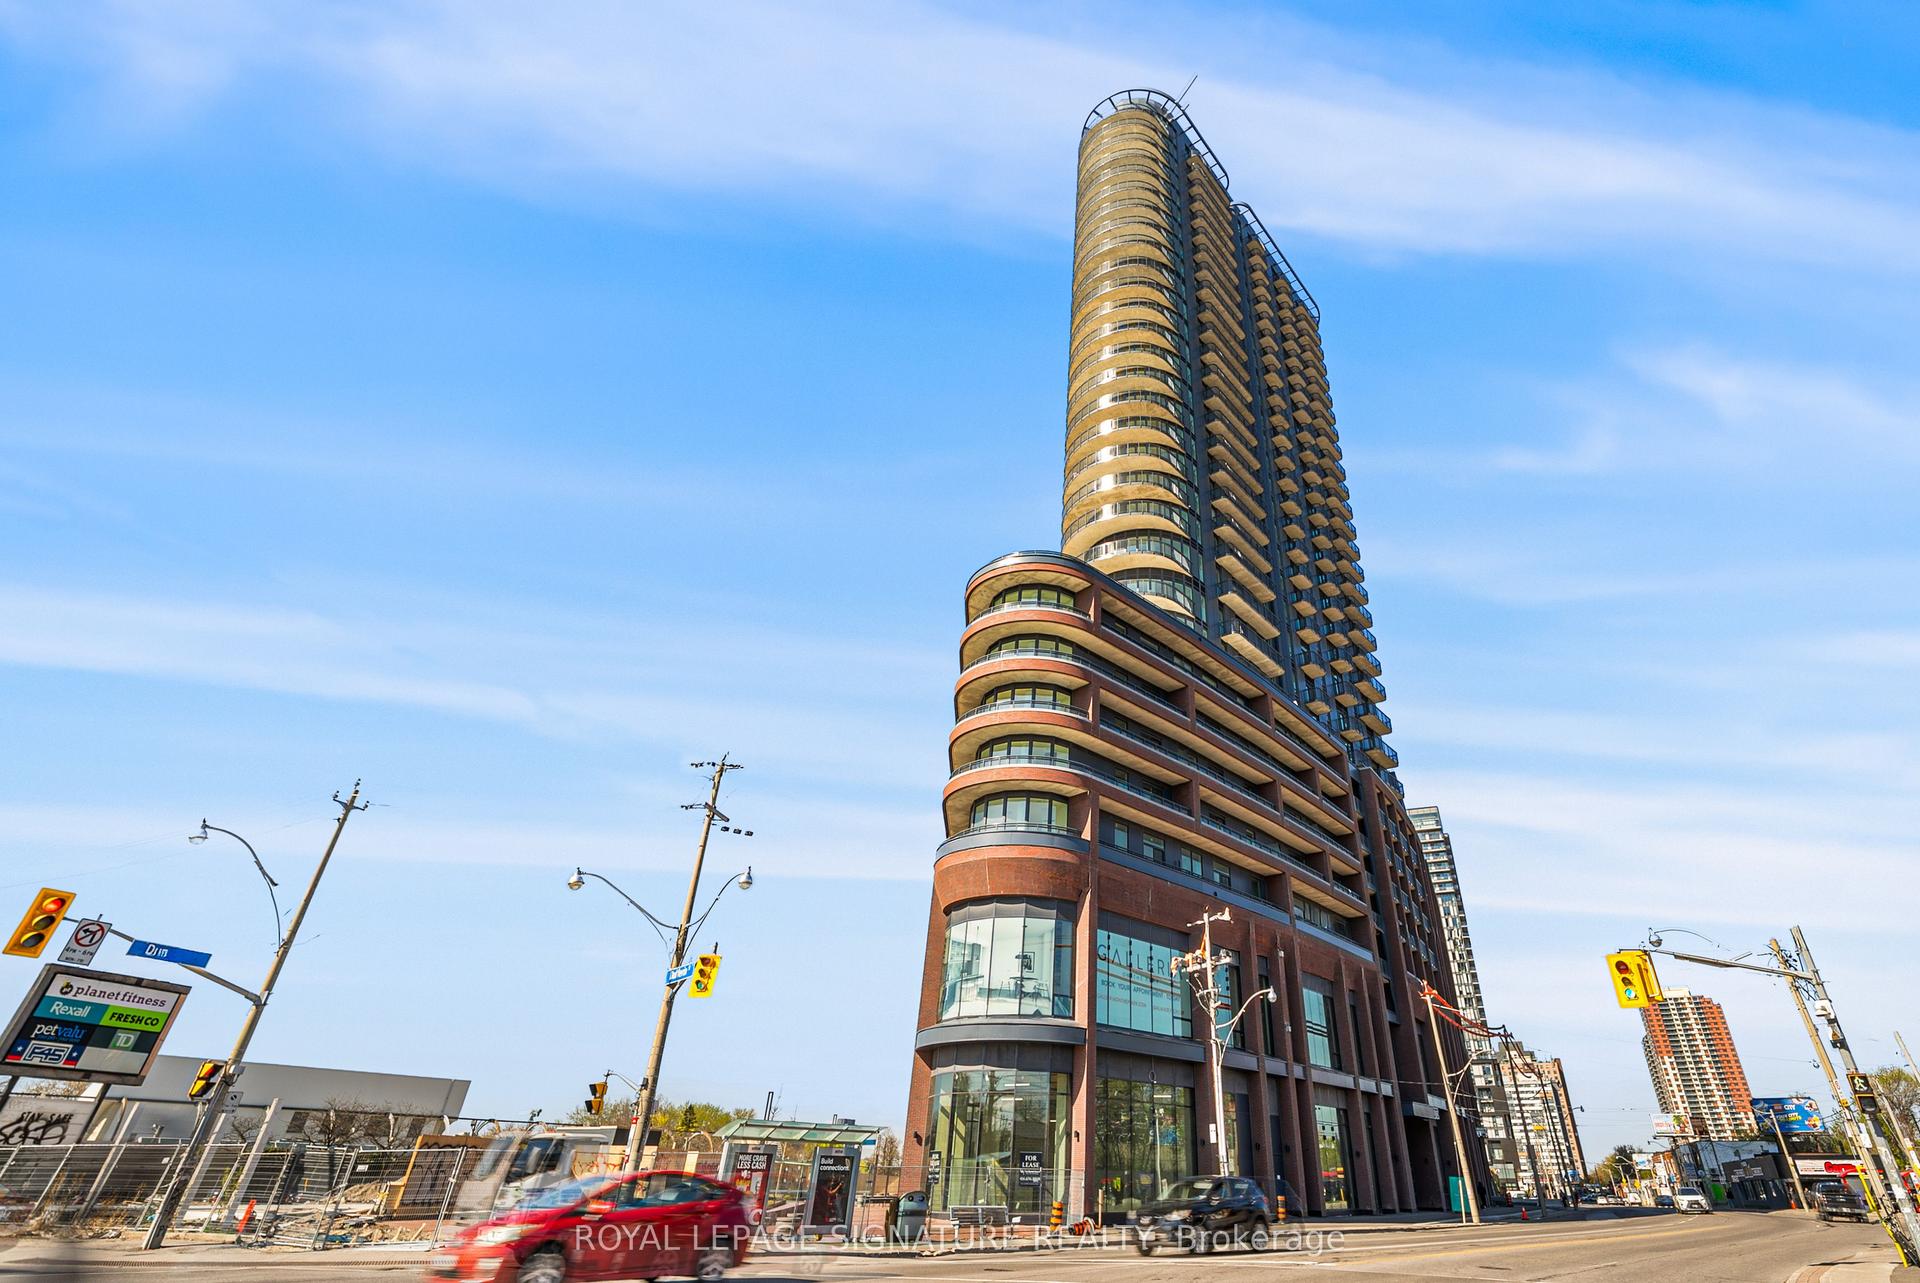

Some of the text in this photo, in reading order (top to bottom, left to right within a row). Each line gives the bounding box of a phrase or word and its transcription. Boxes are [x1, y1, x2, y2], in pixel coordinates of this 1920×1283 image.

[50, 1001, 91, 1018] Rexall
[117, 1032, 135, 1048] TD
[24, 1044, 67, 1064] F45
[21, 1111, 74, 1122] STAY SAFE
[737, 1161, 767, 1170] LESS CASH
